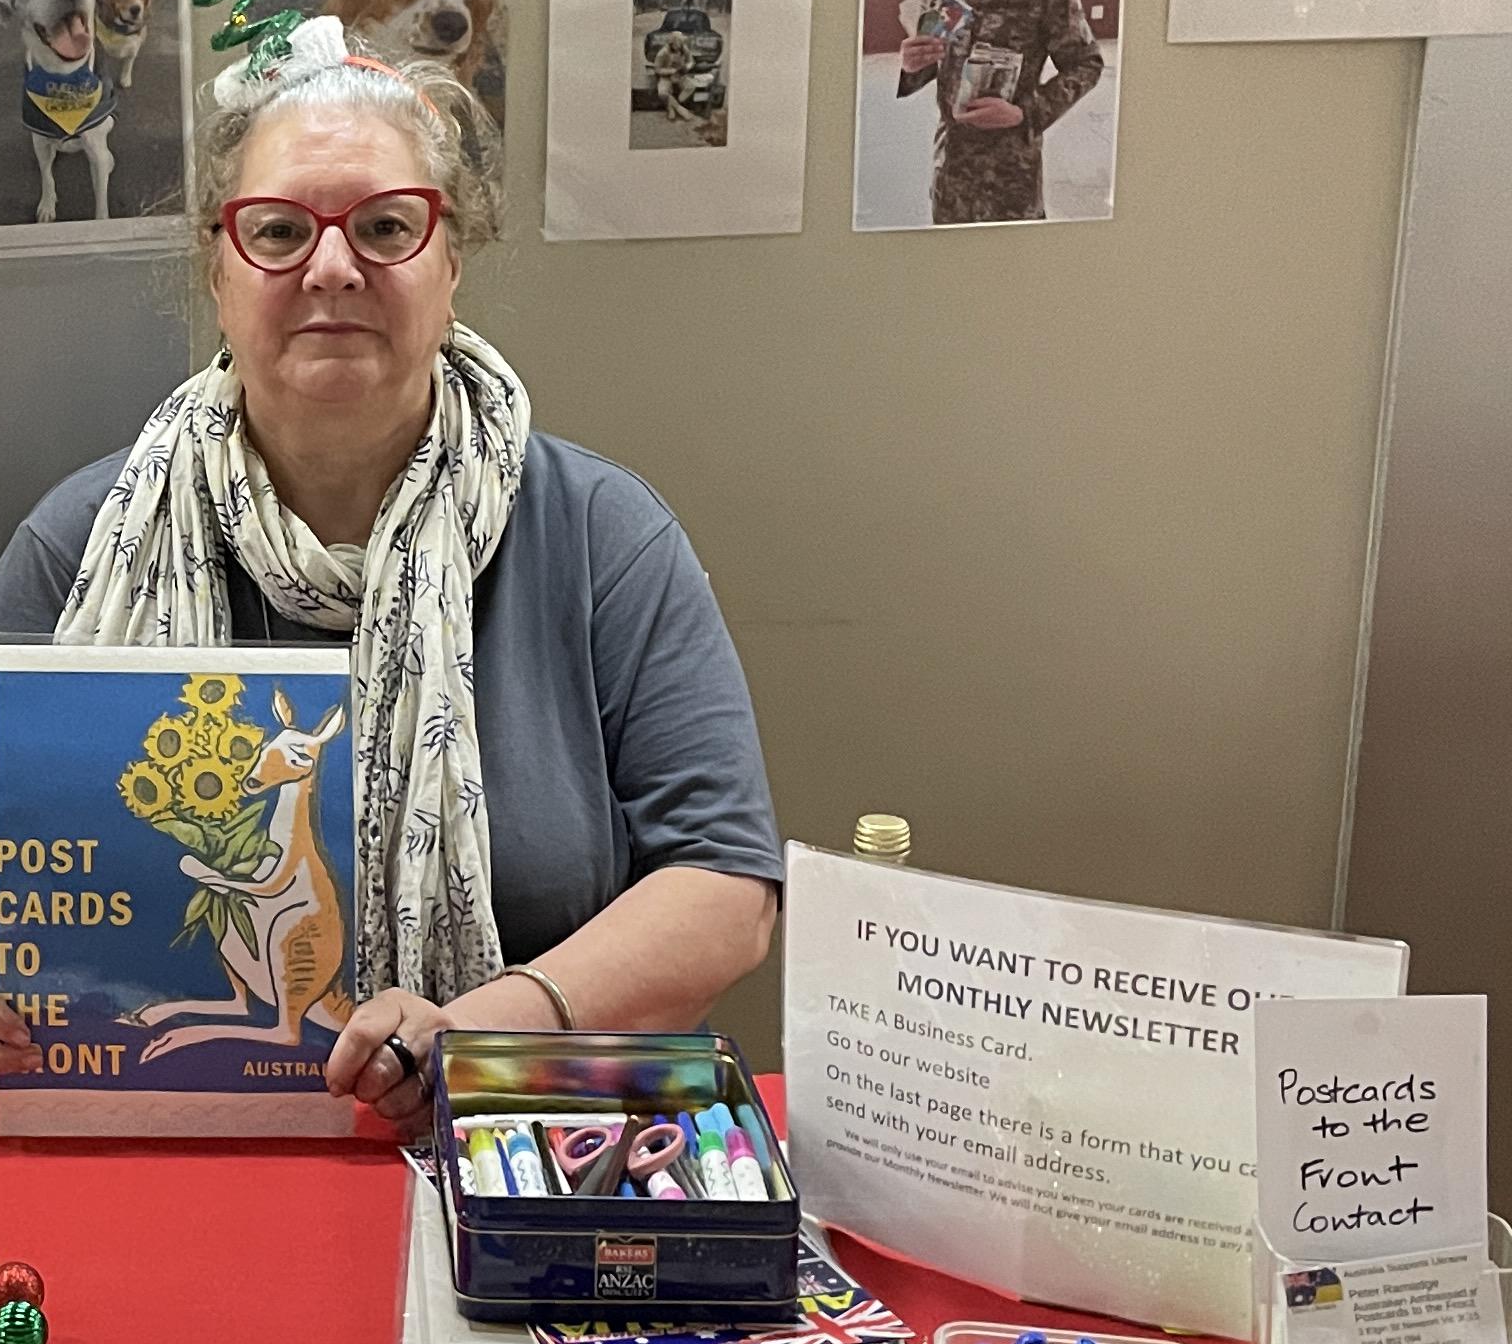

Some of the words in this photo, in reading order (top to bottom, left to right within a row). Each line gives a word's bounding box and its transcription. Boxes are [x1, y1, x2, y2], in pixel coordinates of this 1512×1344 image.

[856, 919, 877, 942] IF
[885, 925, 939, 957] YOU
[949, 940, 1036, 977] WANT
[1044, 958, 1083, 985] TO
[1093, 967, 1217, 1007] RECEIVE
[828, 994, 870, 1021] TAKE
[875, 1009, 888, 1027] A
[893, 1013, 975, 1049] Business
[981, 1035, 1033, 1062] Card.
[897, 971, 1033, 1020] MONTHLY
[1041, 1002, 1239, 1056] NEWSLETTER
[243, 1061, 330, 1077] AUSTRA
[827, 1029, 851, 1050] Go
[857, 1039, 874, 1057] to
[879, 1048, 911, 1068] our
[916, 1057, 991, 1090] website
[1278, 1068, 1437, 1106] Postcards
[826, 1064, 851, 1086] On
[856, 1073, 885, 1096] the
[890, 1082, 921, 1107] last
[927, 1097, 973, 1122] page
[979, 1109, 1033, 1136] there
[1039, 1121, 1054, 1141] is
[1060, 1130, 1072, 1145] a
[1080, 1129, 1131, 1156] form
[1139, 1142, 1183, 1166] that
[1190, 1153, 1231, 1173] you
[1239, 1162, 1258, 1178] ca
[826, 1094, 866, 1120] send
[871, 1110, 910, 1134] with
[916, 1122, 958, 1147] your
[963, 1138, 1018, 1165] email
[1024, 1150, 1111, 1185] address.
[1312, 1115, 1349, 1140] to
[1363, 1109, 1430, 1135] the
[1301, 1154, 1419, 1191] Front
[1292, 1198, 1434, 1233] Contact
[598, 1273, 655, 1289] ANZAC
